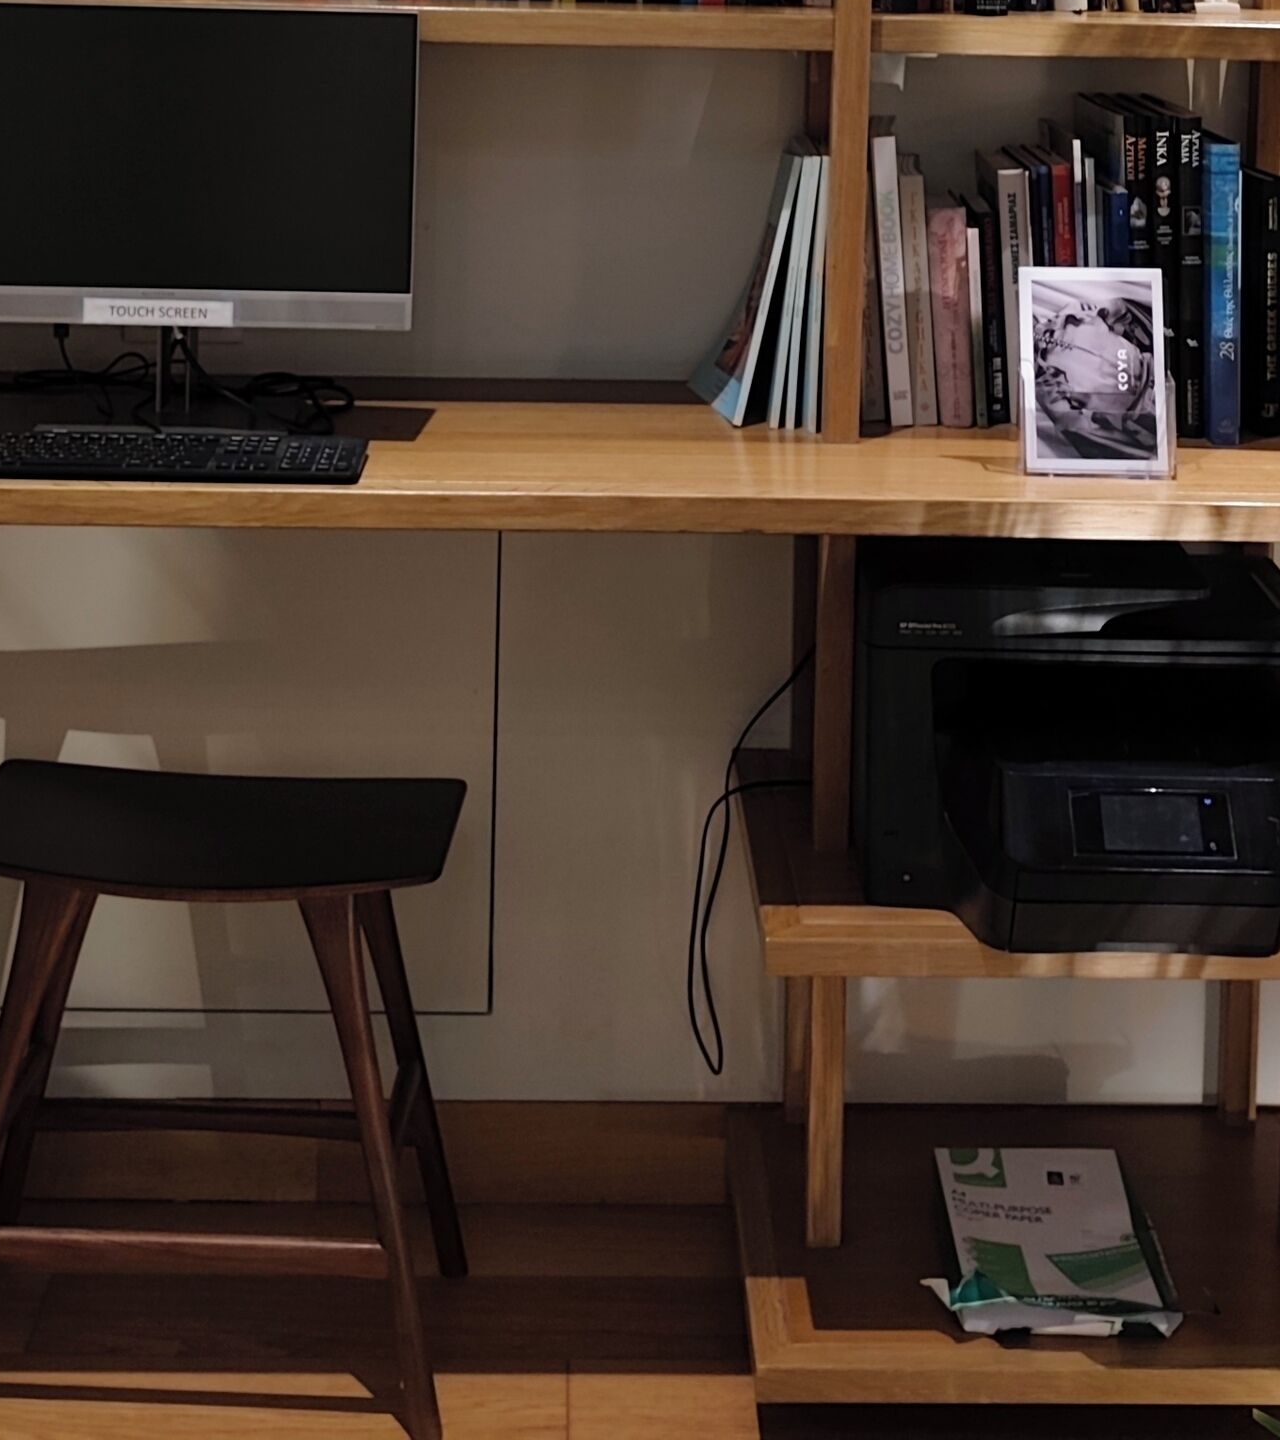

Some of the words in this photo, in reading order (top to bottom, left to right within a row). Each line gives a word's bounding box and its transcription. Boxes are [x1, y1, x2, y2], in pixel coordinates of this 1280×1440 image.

[1125, 134, 1136, 180] ΑΖΤΕΚΟΙ
[1008, 192, 1018, 240] ΣΑΜΑΡΙΑΣ
[1266, 252, 1278, 306] TRIERES
[108, 304, 155, 318] TOUCH
[158, 306, 208, 319] SCREEN
[1266, 308, 1278, 352] GREEK
[1116, 348, 1129, 392] COYA
[1219, 341, 1235, 361] 28
[1266, 354, 1278, 382] THE
